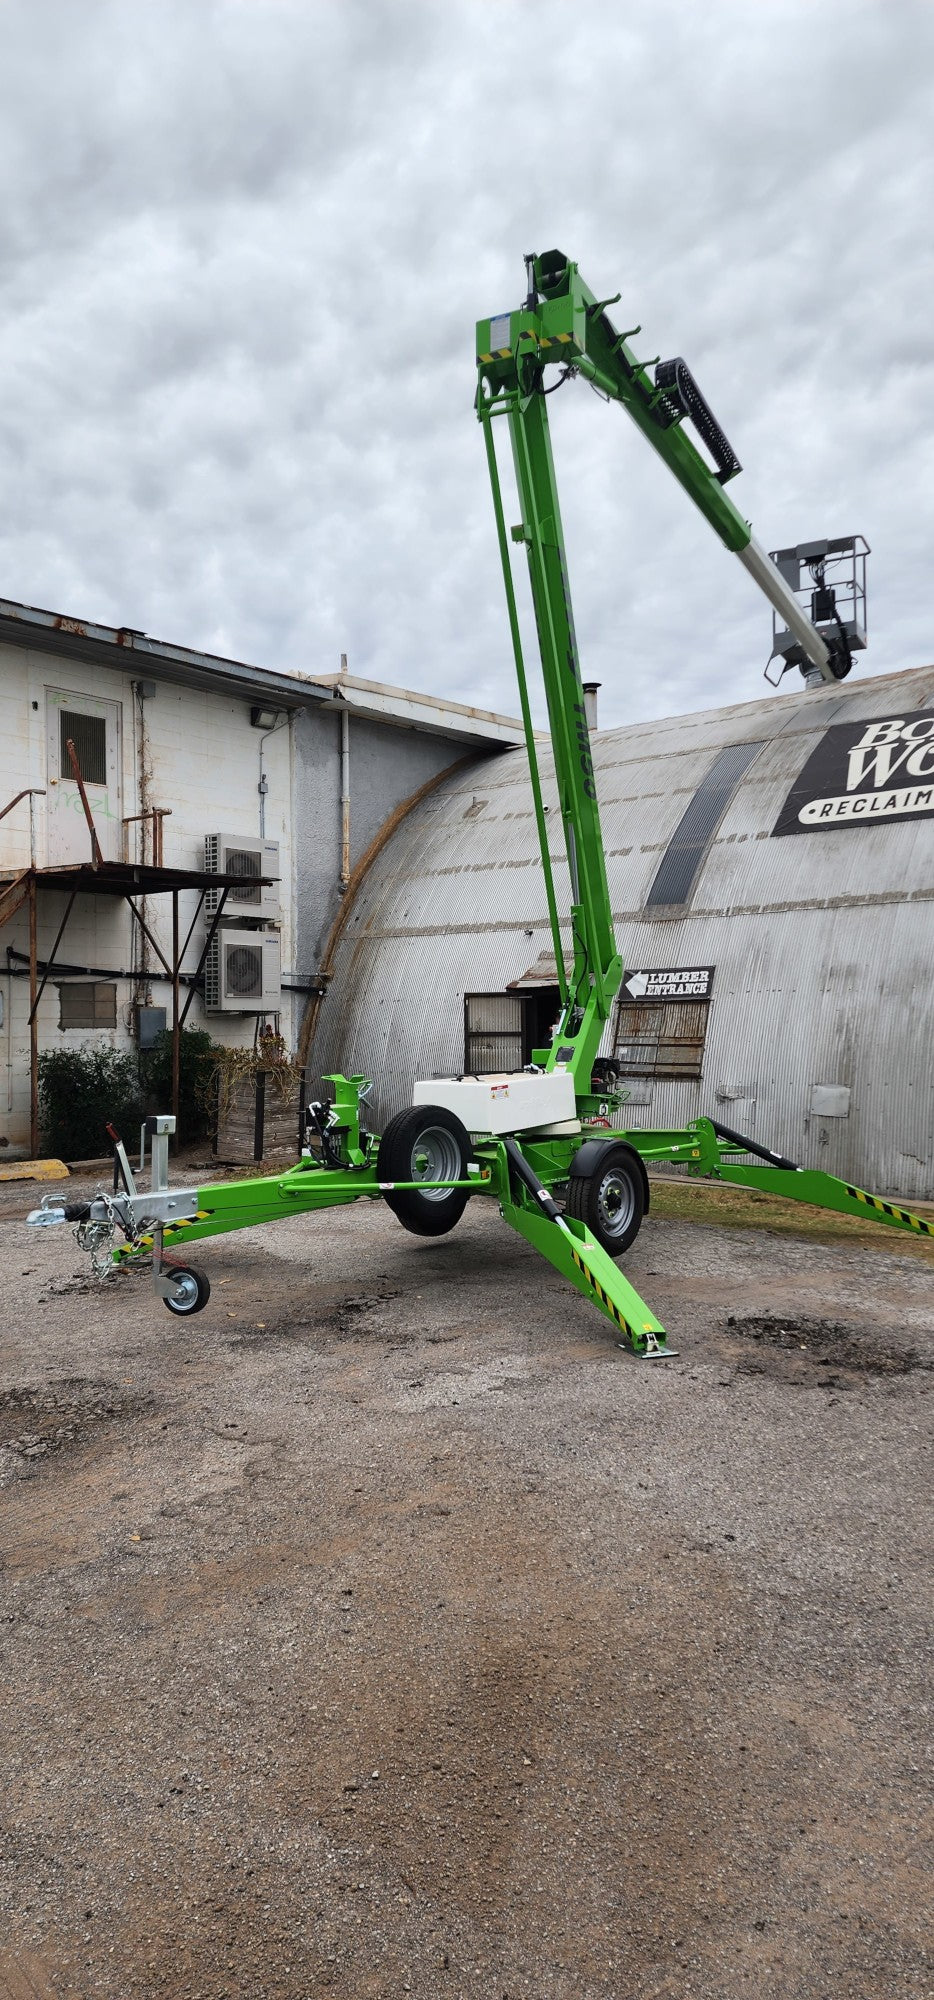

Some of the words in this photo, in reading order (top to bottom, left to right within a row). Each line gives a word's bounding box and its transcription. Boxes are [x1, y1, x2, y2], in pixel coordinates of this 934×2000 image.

[819, 789, 933, 818] RECLAIM
[648, 971, 709, 984] LUMBER
[646, 982, 708, 996] ENTRANCE
